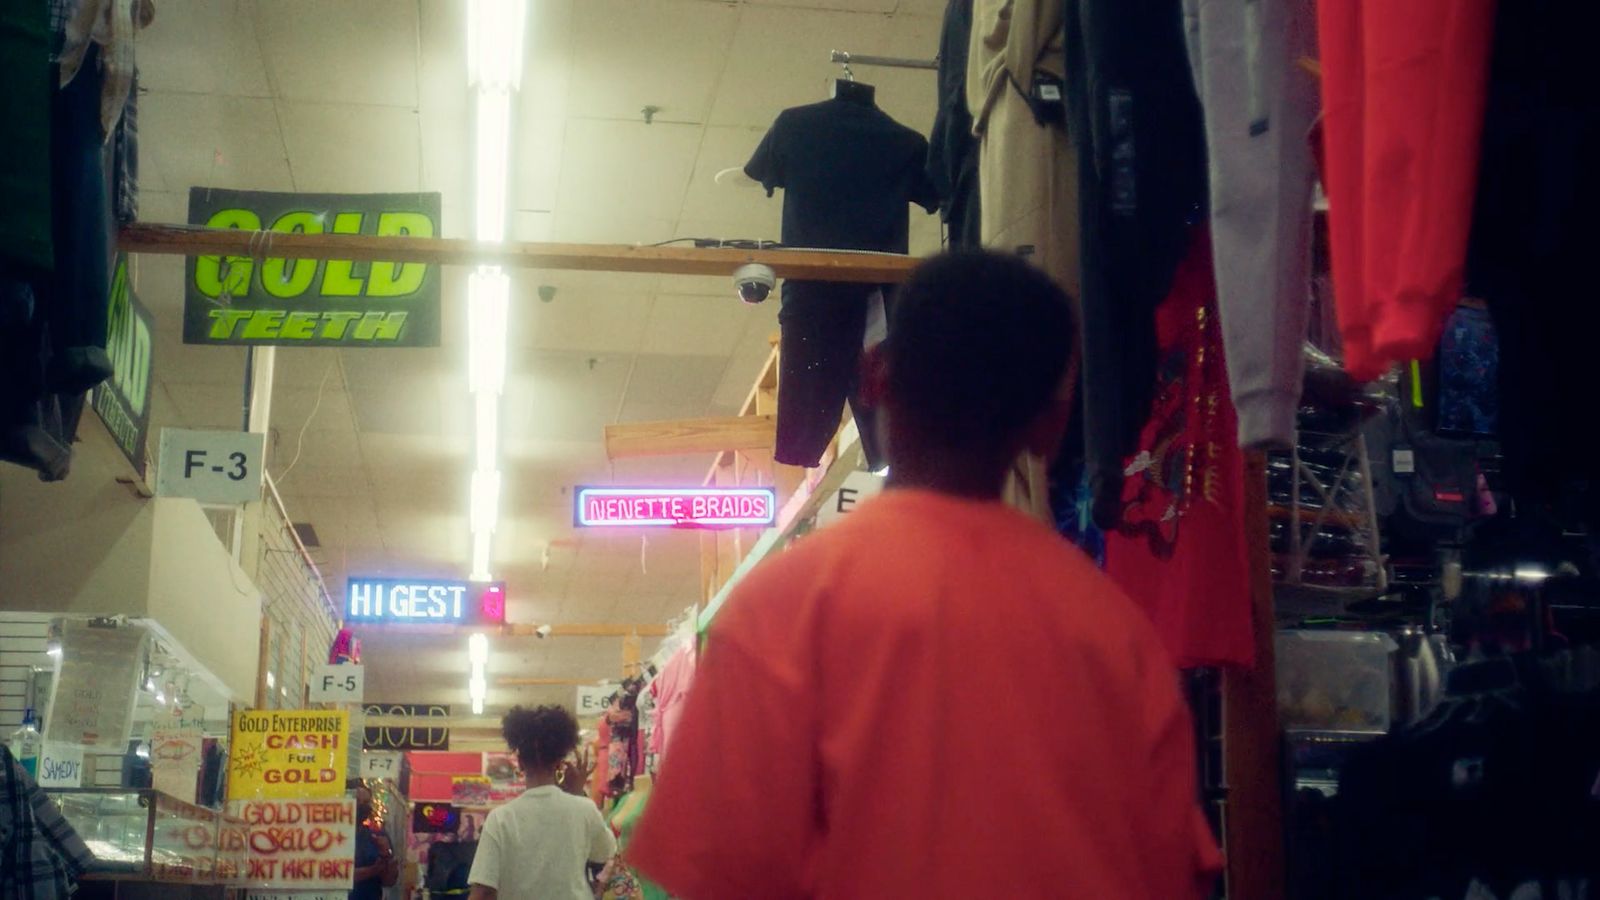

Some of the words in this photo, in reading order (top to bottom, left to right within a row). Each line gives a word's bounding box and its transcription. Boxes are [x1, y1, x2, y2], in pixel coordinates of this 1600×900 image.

[193, 208, 434, 299] GOLD
[207, 309, 409, 341] TEETH
[184, 450, 248, 481] F-3
[589, 497, 685, 520] NENETTE
[691, 496, 766, 518] BRAIDS
[322, 675, 356, 691] F-5
[582, 695, 609, 708] E-6
[240, 714, 269, 732] GOLD
[272, 714, 342, 732] ENTERPRISE
[362, 705, 448, 747] GOLD
[266, 734, 338, 749] CASH
[369, 759, 393, 771] F-7
[264, 769, 337, 783] GOLD
[245, 803, 301, 824] GOLD
[303, 802, 353, 825] TEETH
